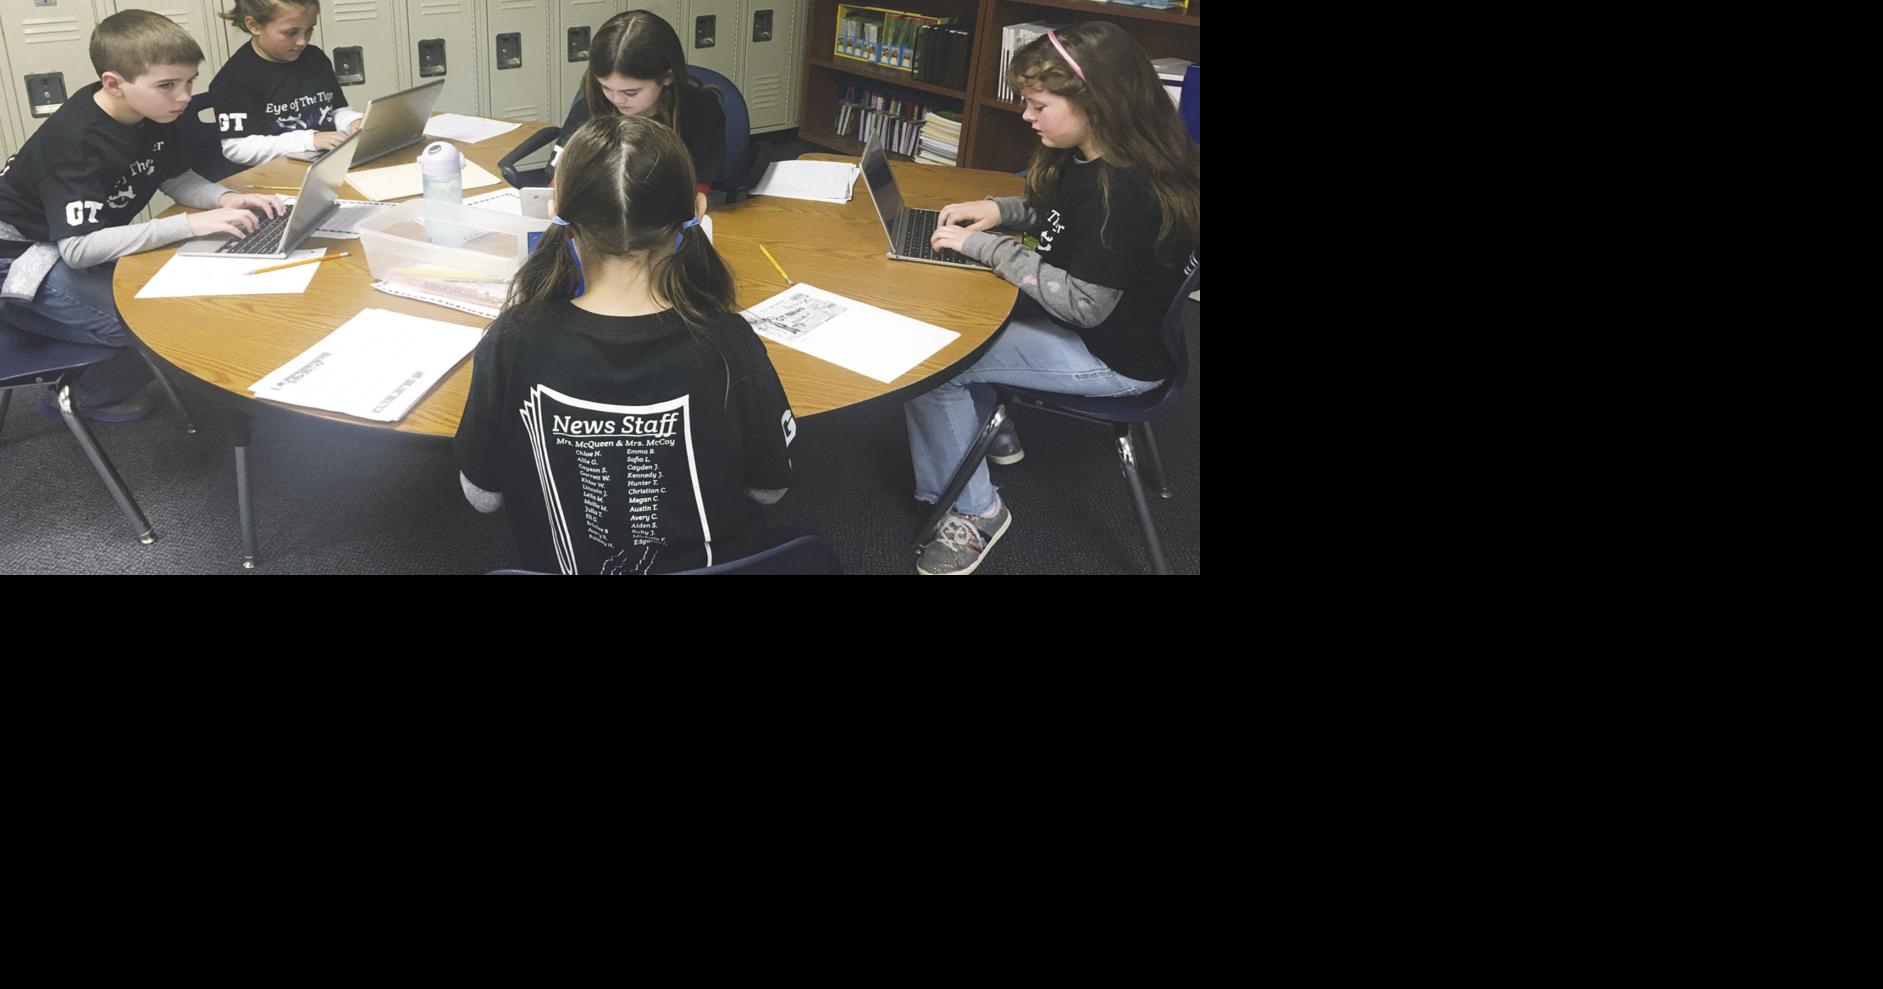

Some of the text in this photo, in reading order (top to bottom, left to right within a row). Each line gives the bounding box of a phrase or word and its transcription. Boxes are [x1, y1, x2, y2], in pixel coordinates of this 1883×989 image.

[265, 103, 288, 115] Eye
[289, 98, 299, 112] of
[218, 112, 248, 132] GT
[65, 200, 104, 227] GT
[552, 412, 680, 438] News Staff
[556, 438, 574, 447] Mrs.
[575, 440, 614, 449] McQueen
[645, 438, 676, 447] McCoy
[575, 449, 594, 457] Chloe
[628, 487, 660, 495] Christian
[628, 497, 652, 505] Megan
[629, 505, 652, 513] Austin
